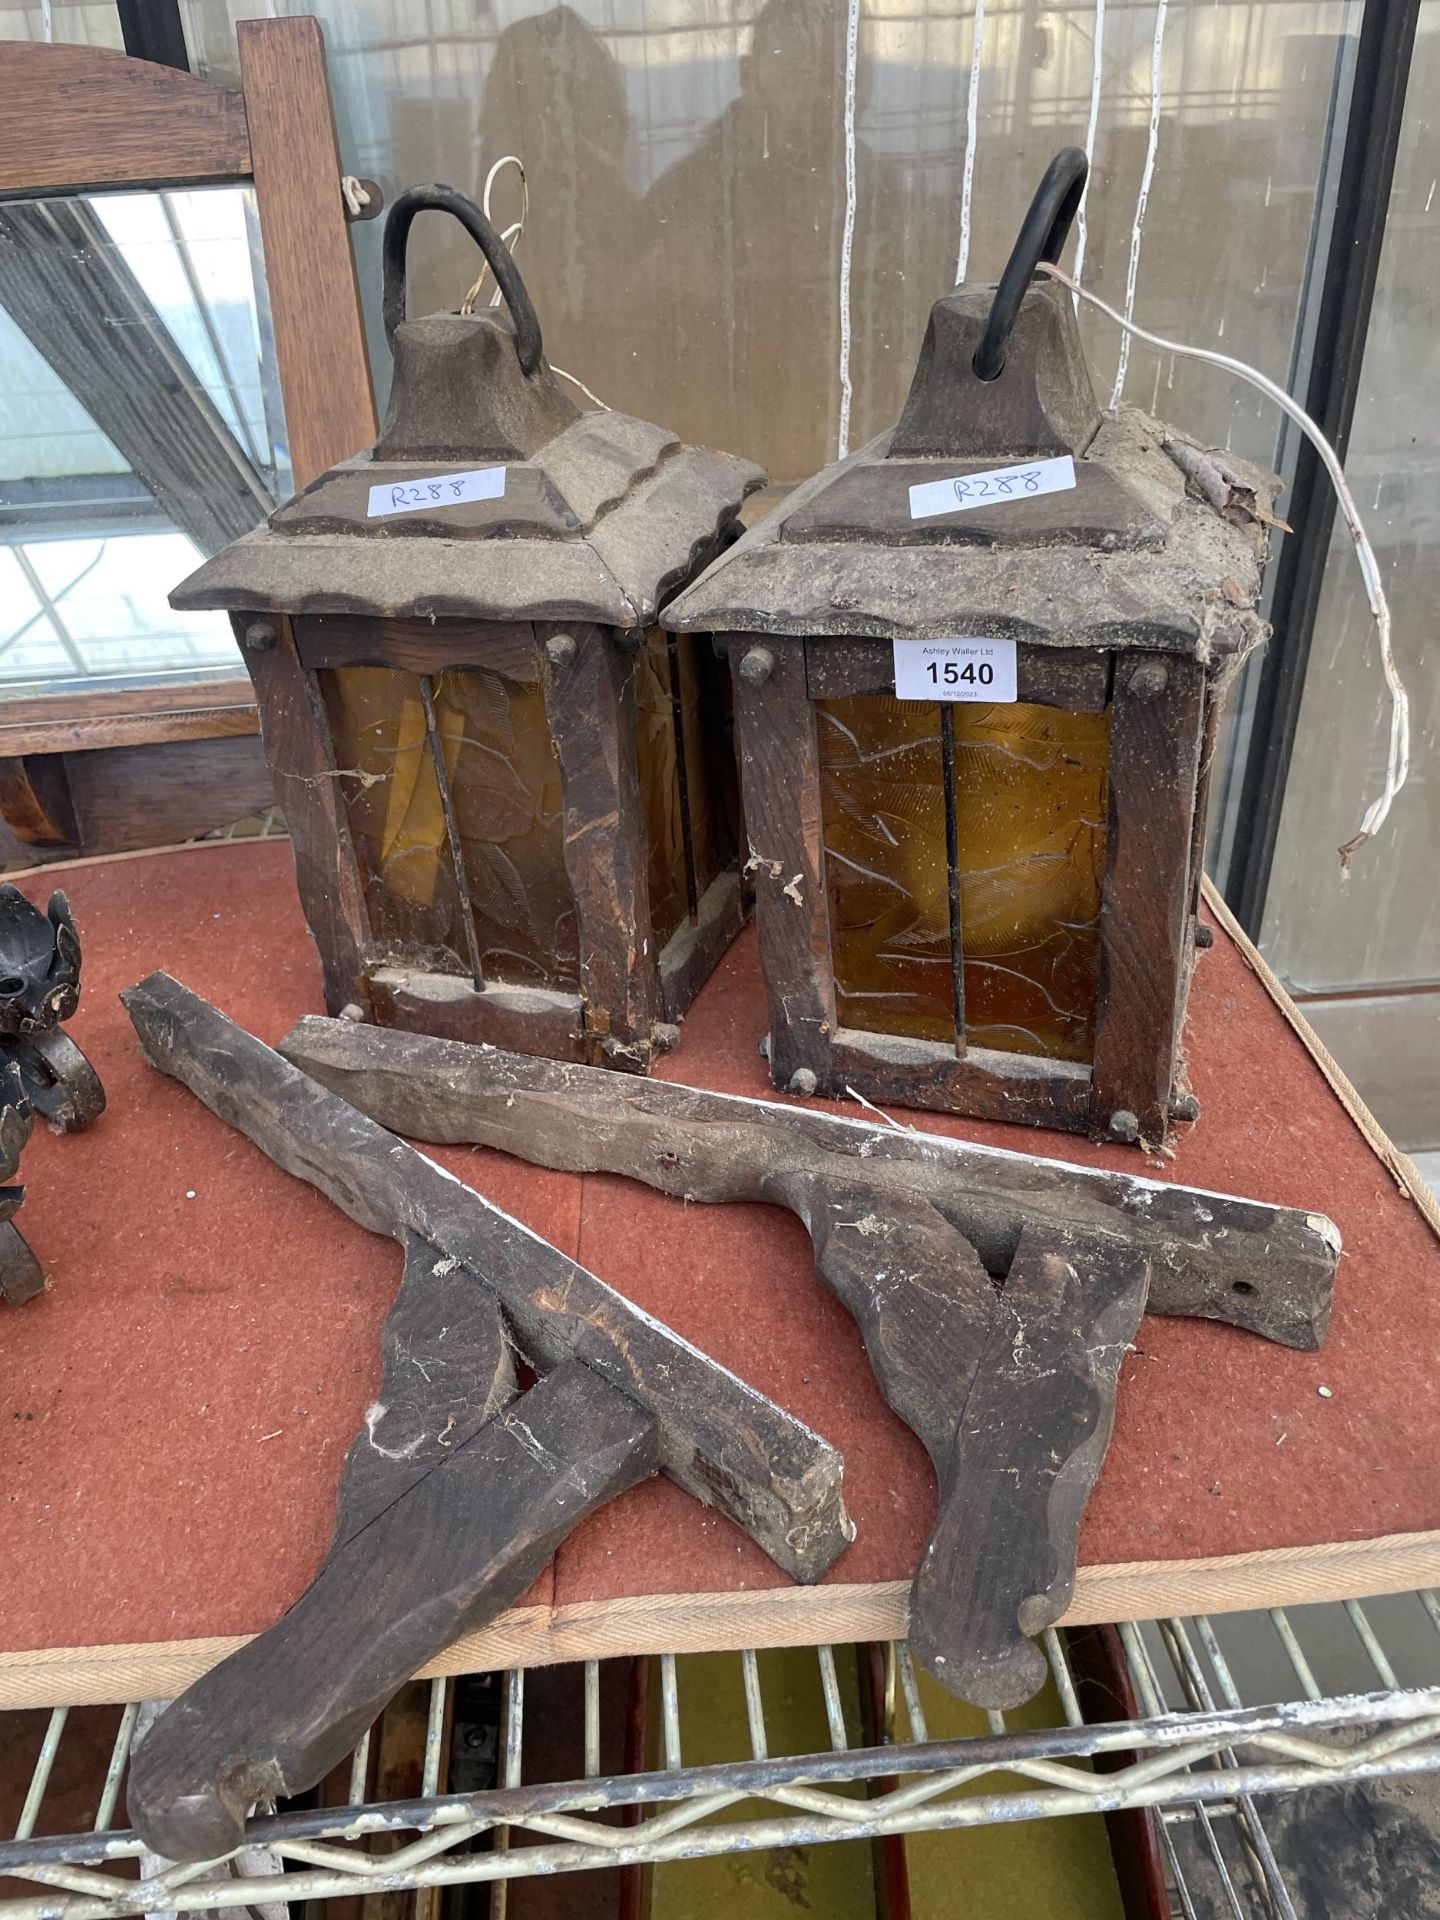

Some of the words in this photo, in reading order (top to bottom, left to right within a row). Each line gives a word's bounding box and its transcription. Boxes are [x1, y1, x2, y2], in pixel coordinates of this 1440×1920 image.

[391, 480, 467, 508] R288
[954, 471, 1042, 502] R288
[922, 647, 951, 657] Ashley
[952, 647, 979, 656] Waller
[980, 648, 994, 656] Ltd
[926, 661, 994, 685] 1540
